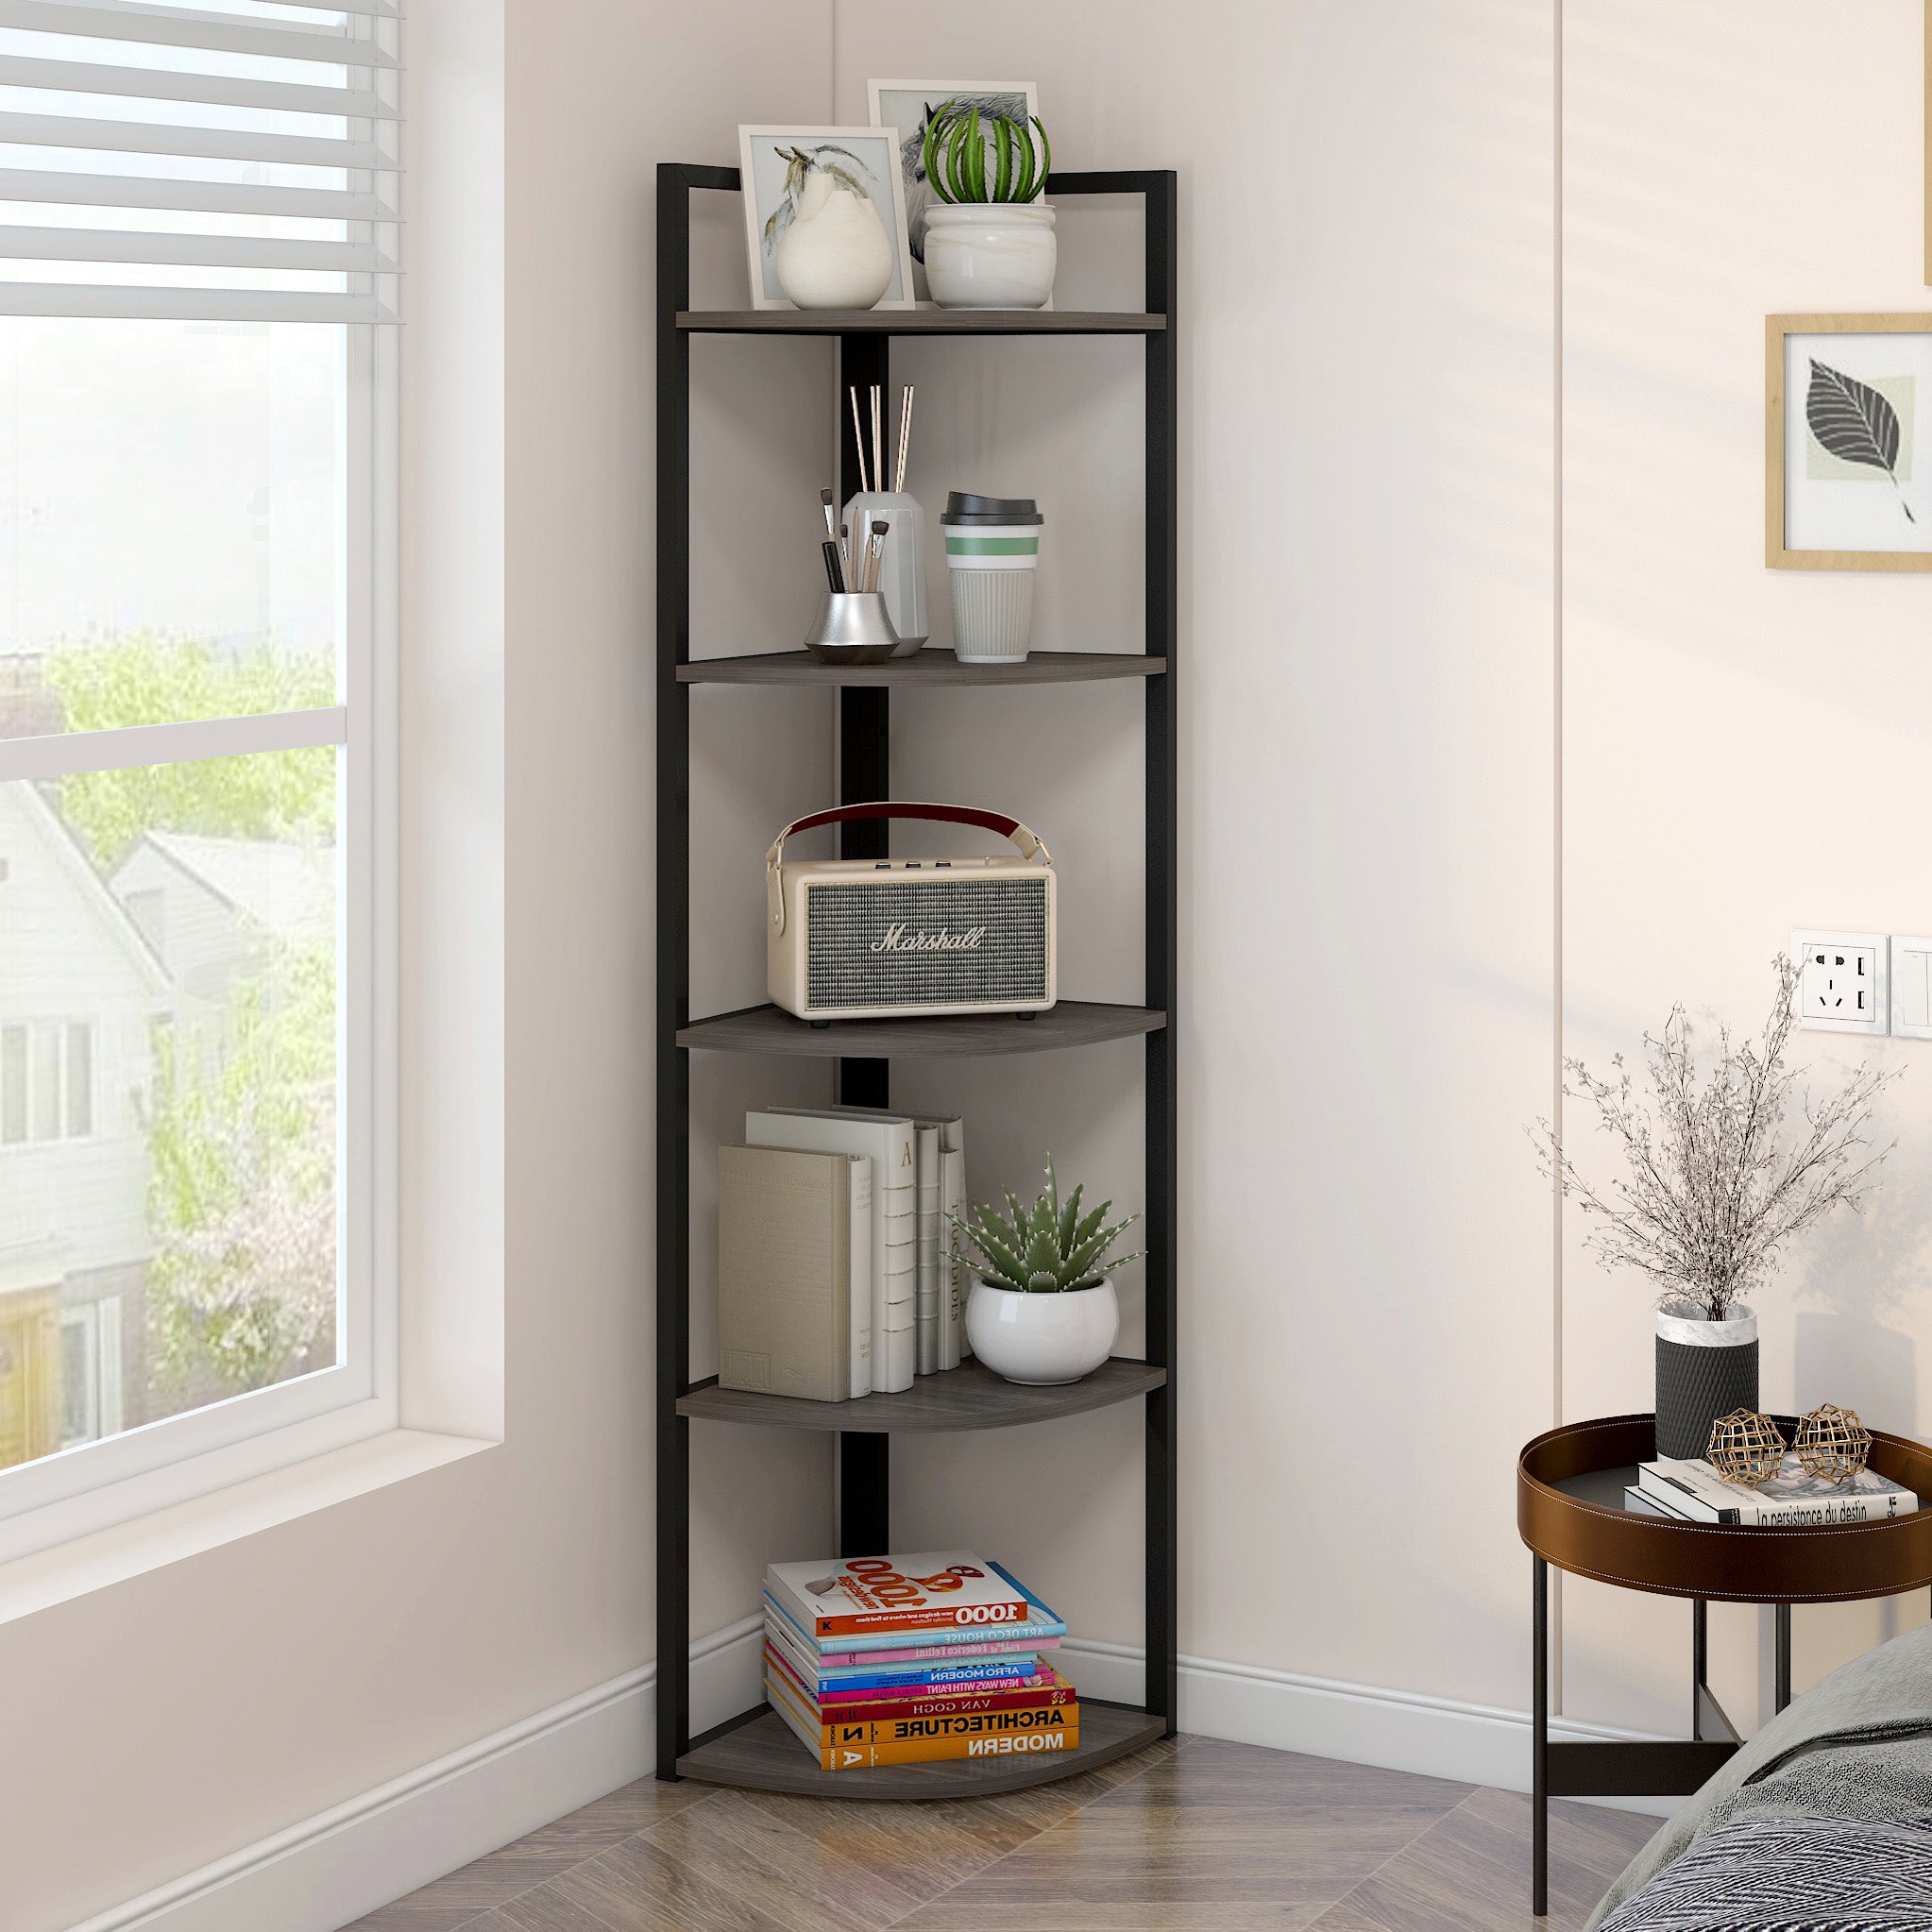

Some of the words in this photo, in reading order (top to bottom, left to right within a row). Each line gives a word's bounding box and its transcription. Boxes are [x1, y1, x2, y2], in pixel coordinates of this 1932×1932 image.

[871, 922, 986, 952] Marshall
[900, 1141, 912, 1167] A
[1825, 1501, 1837, 1524] du
[1839, 1500, 1867, 1523] destin
